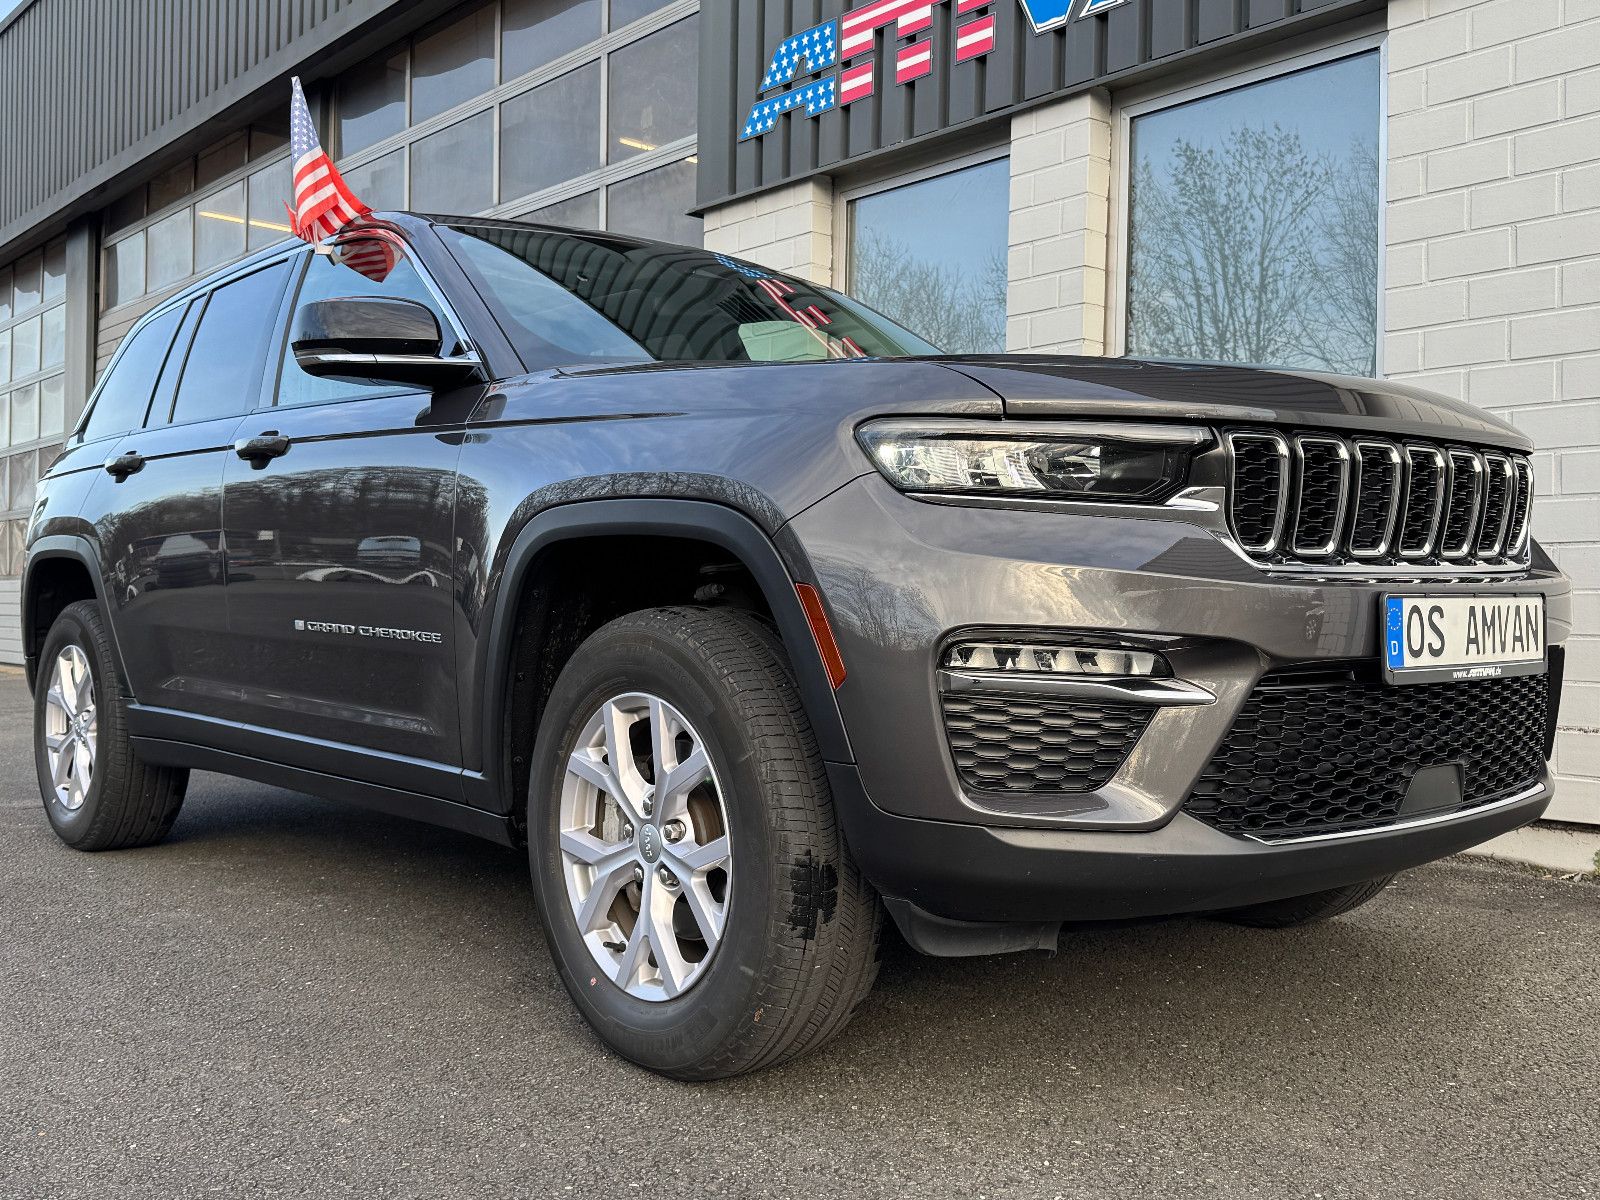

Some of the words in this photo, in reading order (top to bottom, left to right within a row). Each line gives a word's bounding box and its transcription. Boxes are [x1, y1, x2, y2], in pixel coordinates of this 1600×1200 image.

[306, 620, 356, 635] GRAND
[358, 625, 443, 644] CHEROKEE
[1406, 604, 1446, 659] OS
[1465, 604, 1539, 656] AMVAN
[1391, 640, 1399, 656] D
